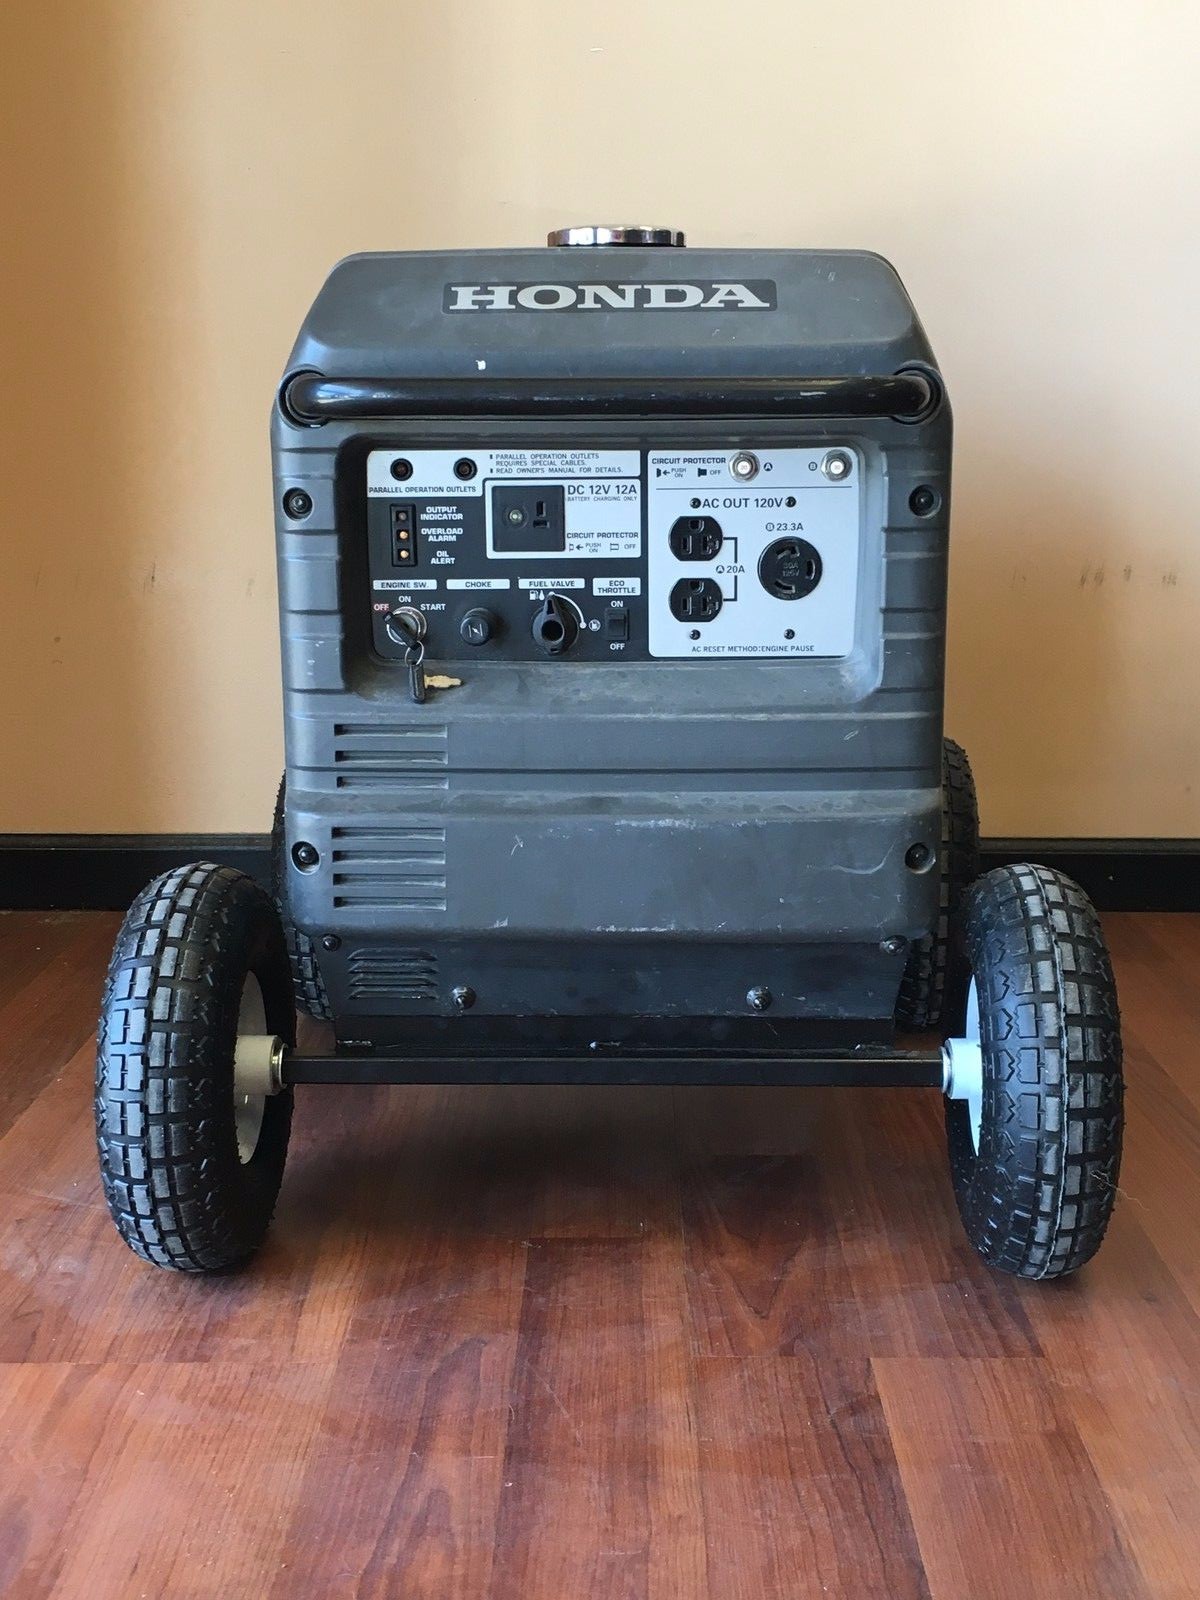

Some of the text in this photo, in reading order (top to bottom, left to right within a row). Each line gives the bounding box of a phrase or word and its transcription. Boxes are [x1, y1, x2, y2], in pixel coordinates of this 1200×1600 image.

[449, 284, 770, 310] HONDA
[567, 484, 637, 495] DC 12V 12A
[702, 497, 784, 508] AC OUT 120V
[776, 522, 804, 531] 23.3A
[726, 565, 745, 574] 20A
[413, 581, 429, 589] SW.
[398, 595, 411, 603] ON
[373, 603, 389, 611] OFF
[610, 600, 624, 608] ON
